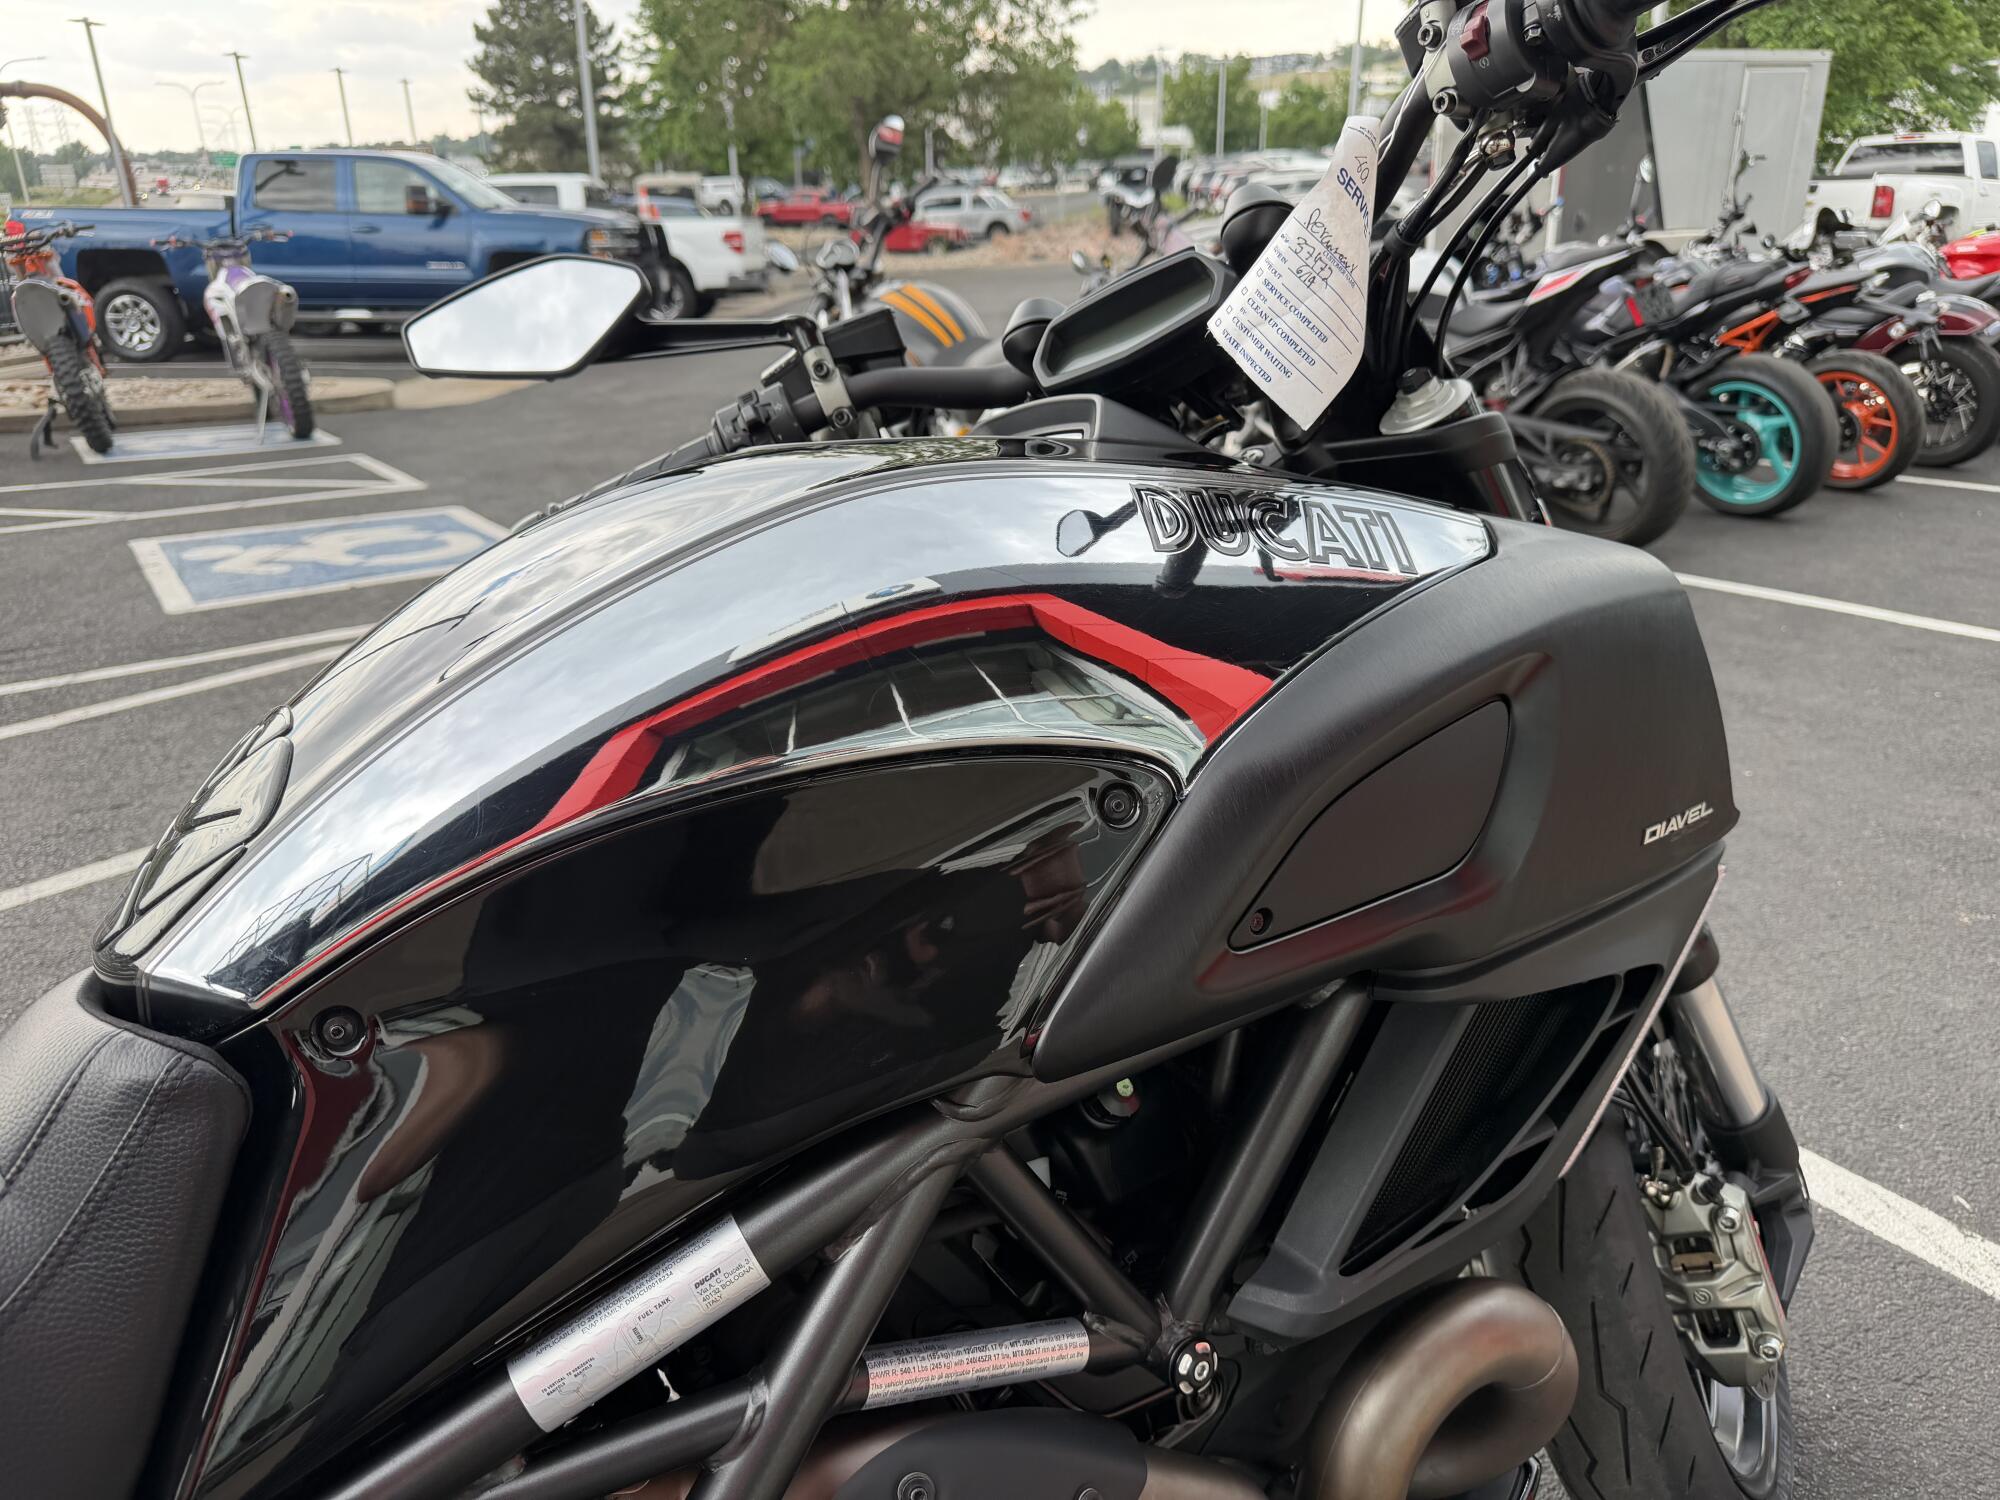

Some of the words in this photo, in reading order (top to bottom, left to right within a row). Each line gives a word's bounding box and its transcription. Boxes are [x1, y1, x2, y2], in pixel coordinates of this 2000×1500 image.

[1323, 251, 1346, 275] CUSTOMER
[1262, 278, 1290, 307] SERVICE
[1288, 305, 1328, 344] COMPLETED
[1232, 316, 1264, 353] CUSTOMER
[1264, 348, 1293, 379] WAITING
[1247, 297, 1269, 322] CLEAN
[1268, 318, 1279, 331] UP
[1276, 327, 1316, 367] COMPLETED
[1222, 328, 1242, 353] STATE
[1239, 348, 1272, 383] INSPECTED
[1130, 483, 1418, 576] DUCATI
[1643, 801, 1714, 845] DIAVEL
[693, 1267, 722, 1289] DUCATI
[696, 1286, 708, 1296] Via
[700, 1286, 721, 1302] 40132
[719, 1264, 754, 1290] BOLOGNA
[576, 1319, 586, 1329] TO
[585, 1309, 602, 1322] 2013
[601, 1293, 626, 1312] MODEL
[625, 1281, 645, 1296] YEAR
[644, 1270, 662, 1284] NEW
[637, 1308, 653, 1321] FUEL
[653, 1296, 671, 1310] TANK
[704, 1294, 723, 1309] ITALY
[580, 1319, 599, 1334] EVAP
[869, 1369, 890, 1379] GAWR
